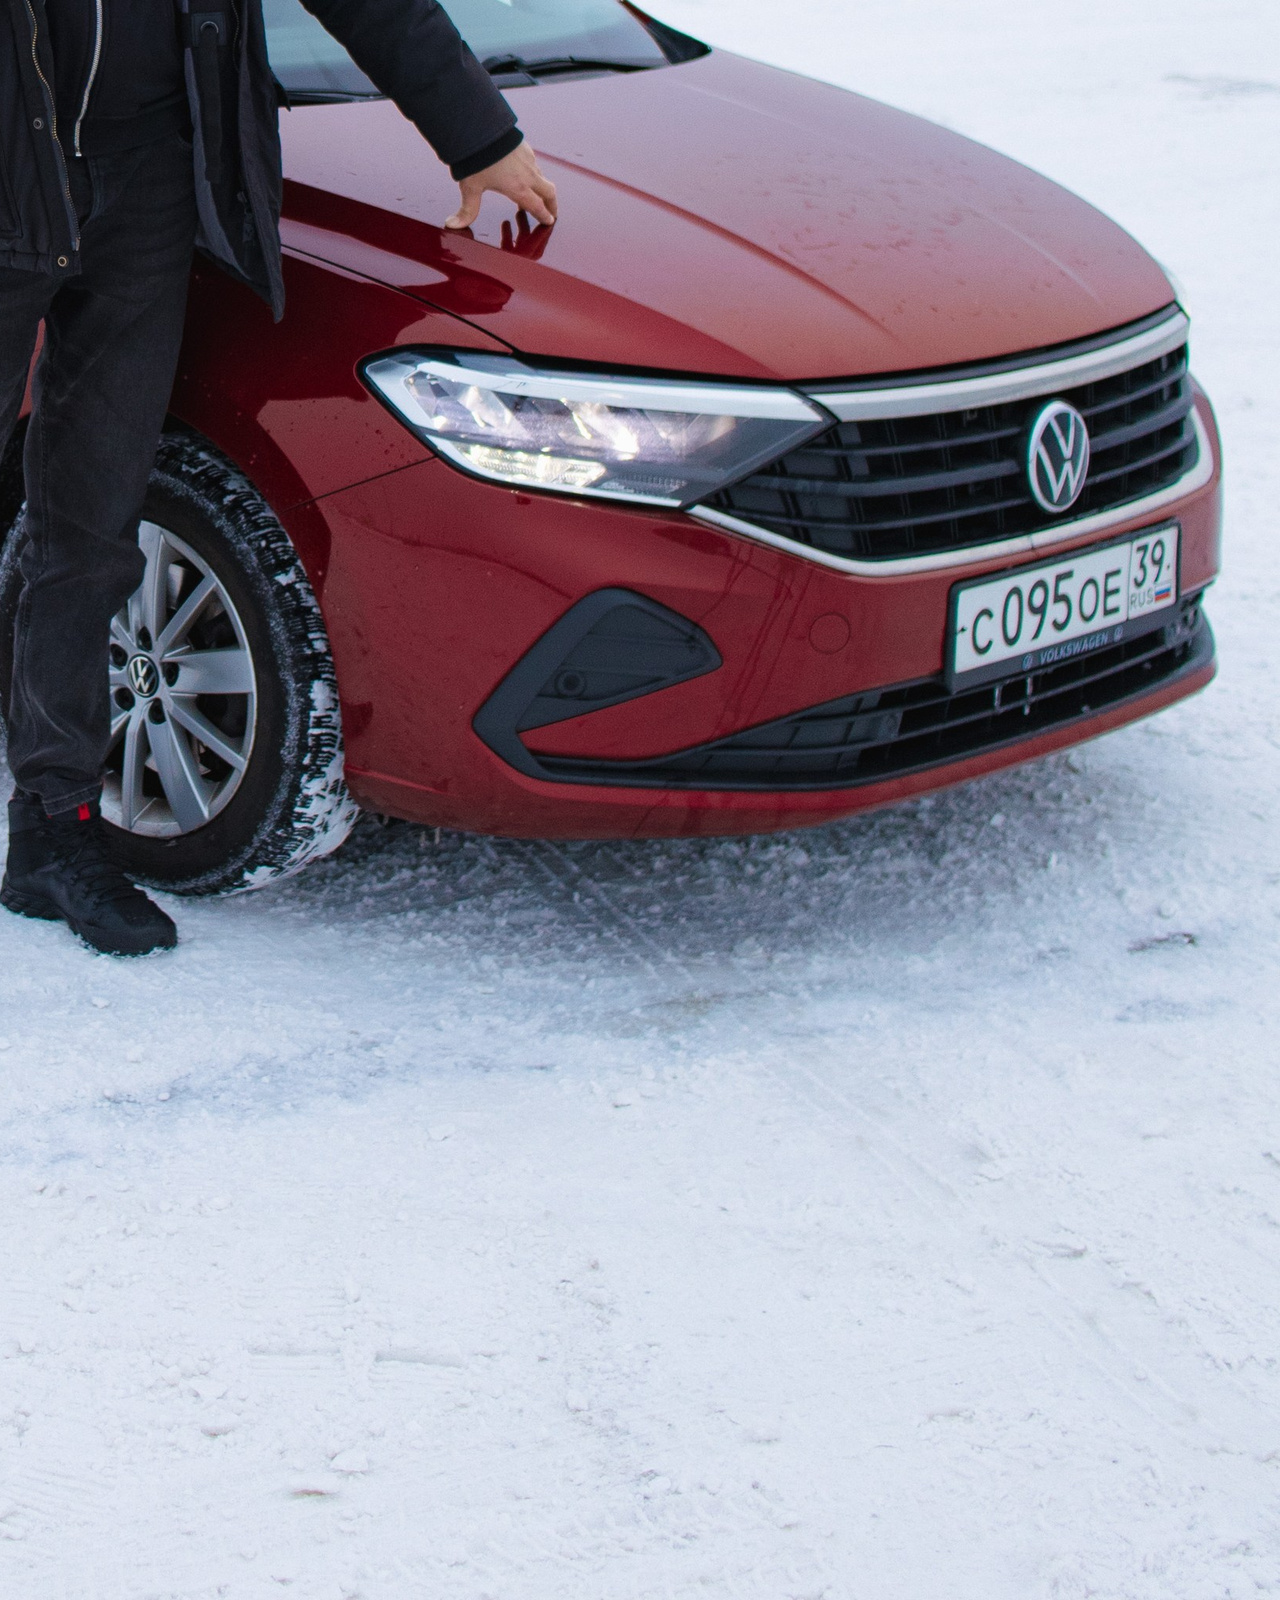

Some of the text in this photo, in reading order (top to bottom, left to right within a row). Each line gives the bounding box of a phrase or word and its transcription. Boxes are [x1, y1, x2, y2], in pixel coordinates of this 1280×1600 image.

[1133, 538, 1166, 589] 39
[1130, 589, 1153, 607] RUS
[1039, 634, 1109, 666] VOLKSWAGEN
